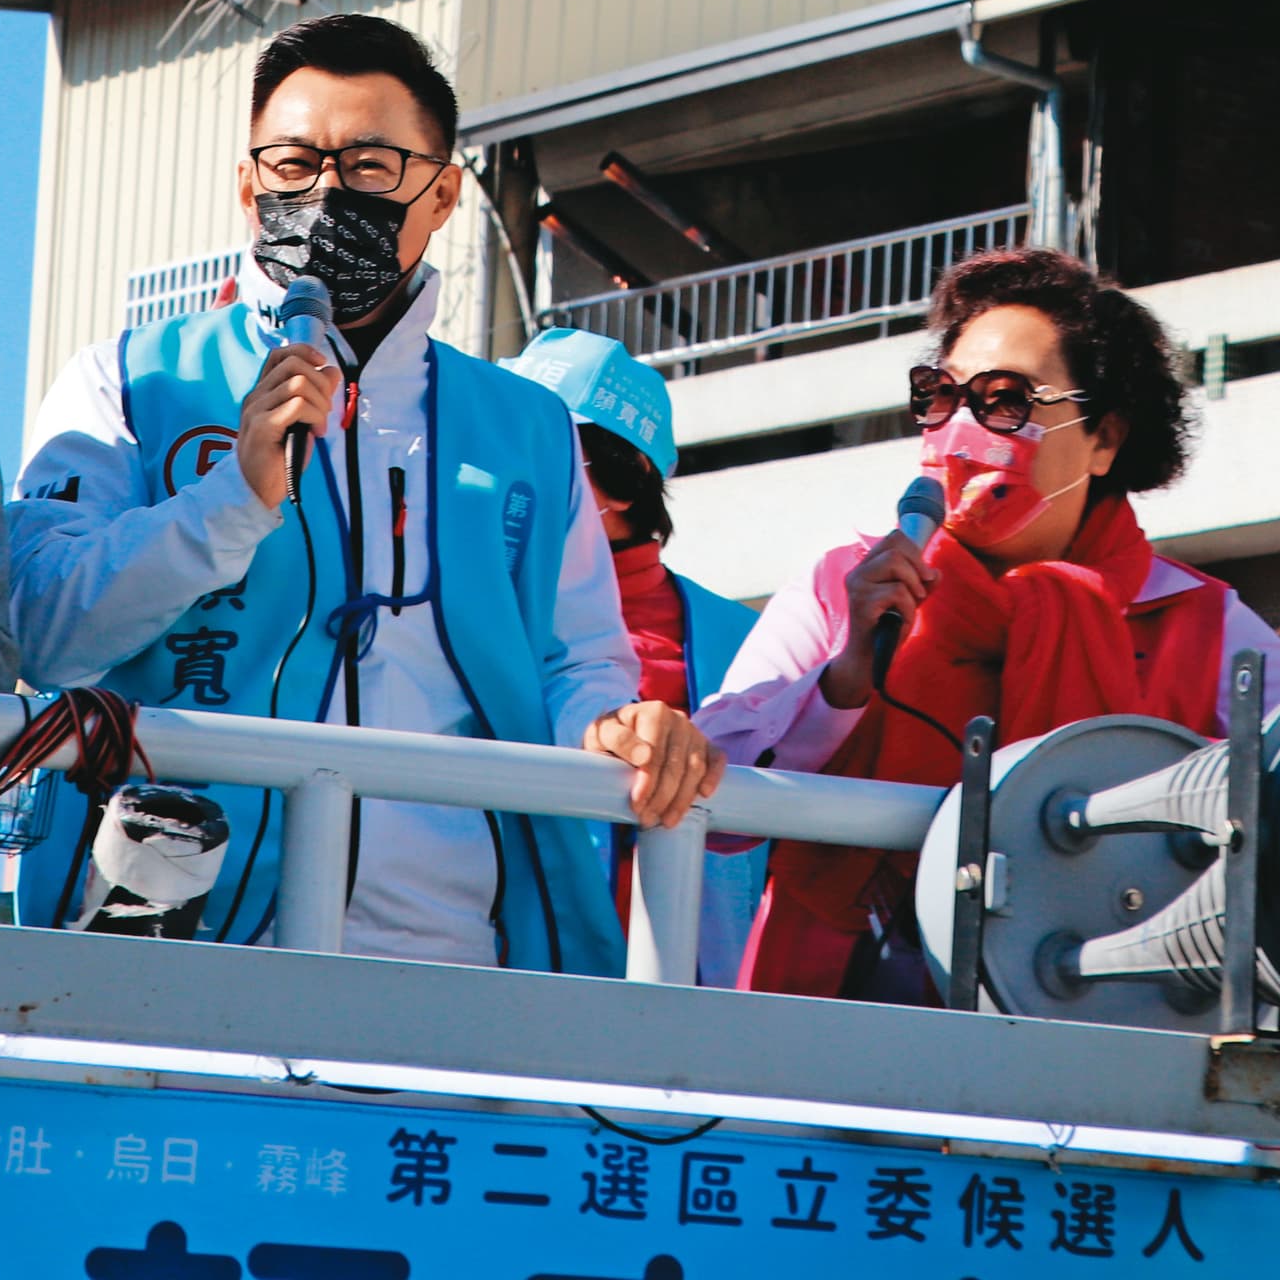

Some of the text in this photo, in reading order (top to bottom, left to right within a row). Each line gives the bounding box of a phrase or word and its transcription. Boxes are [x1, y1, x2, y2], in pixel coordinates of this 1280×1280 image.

[106, 1132, 199, 1185] 烏日
[256, 1143, 349, 1197] 霧峰
[385, 1126, 1206, 1262] 第二選區立委候選人
